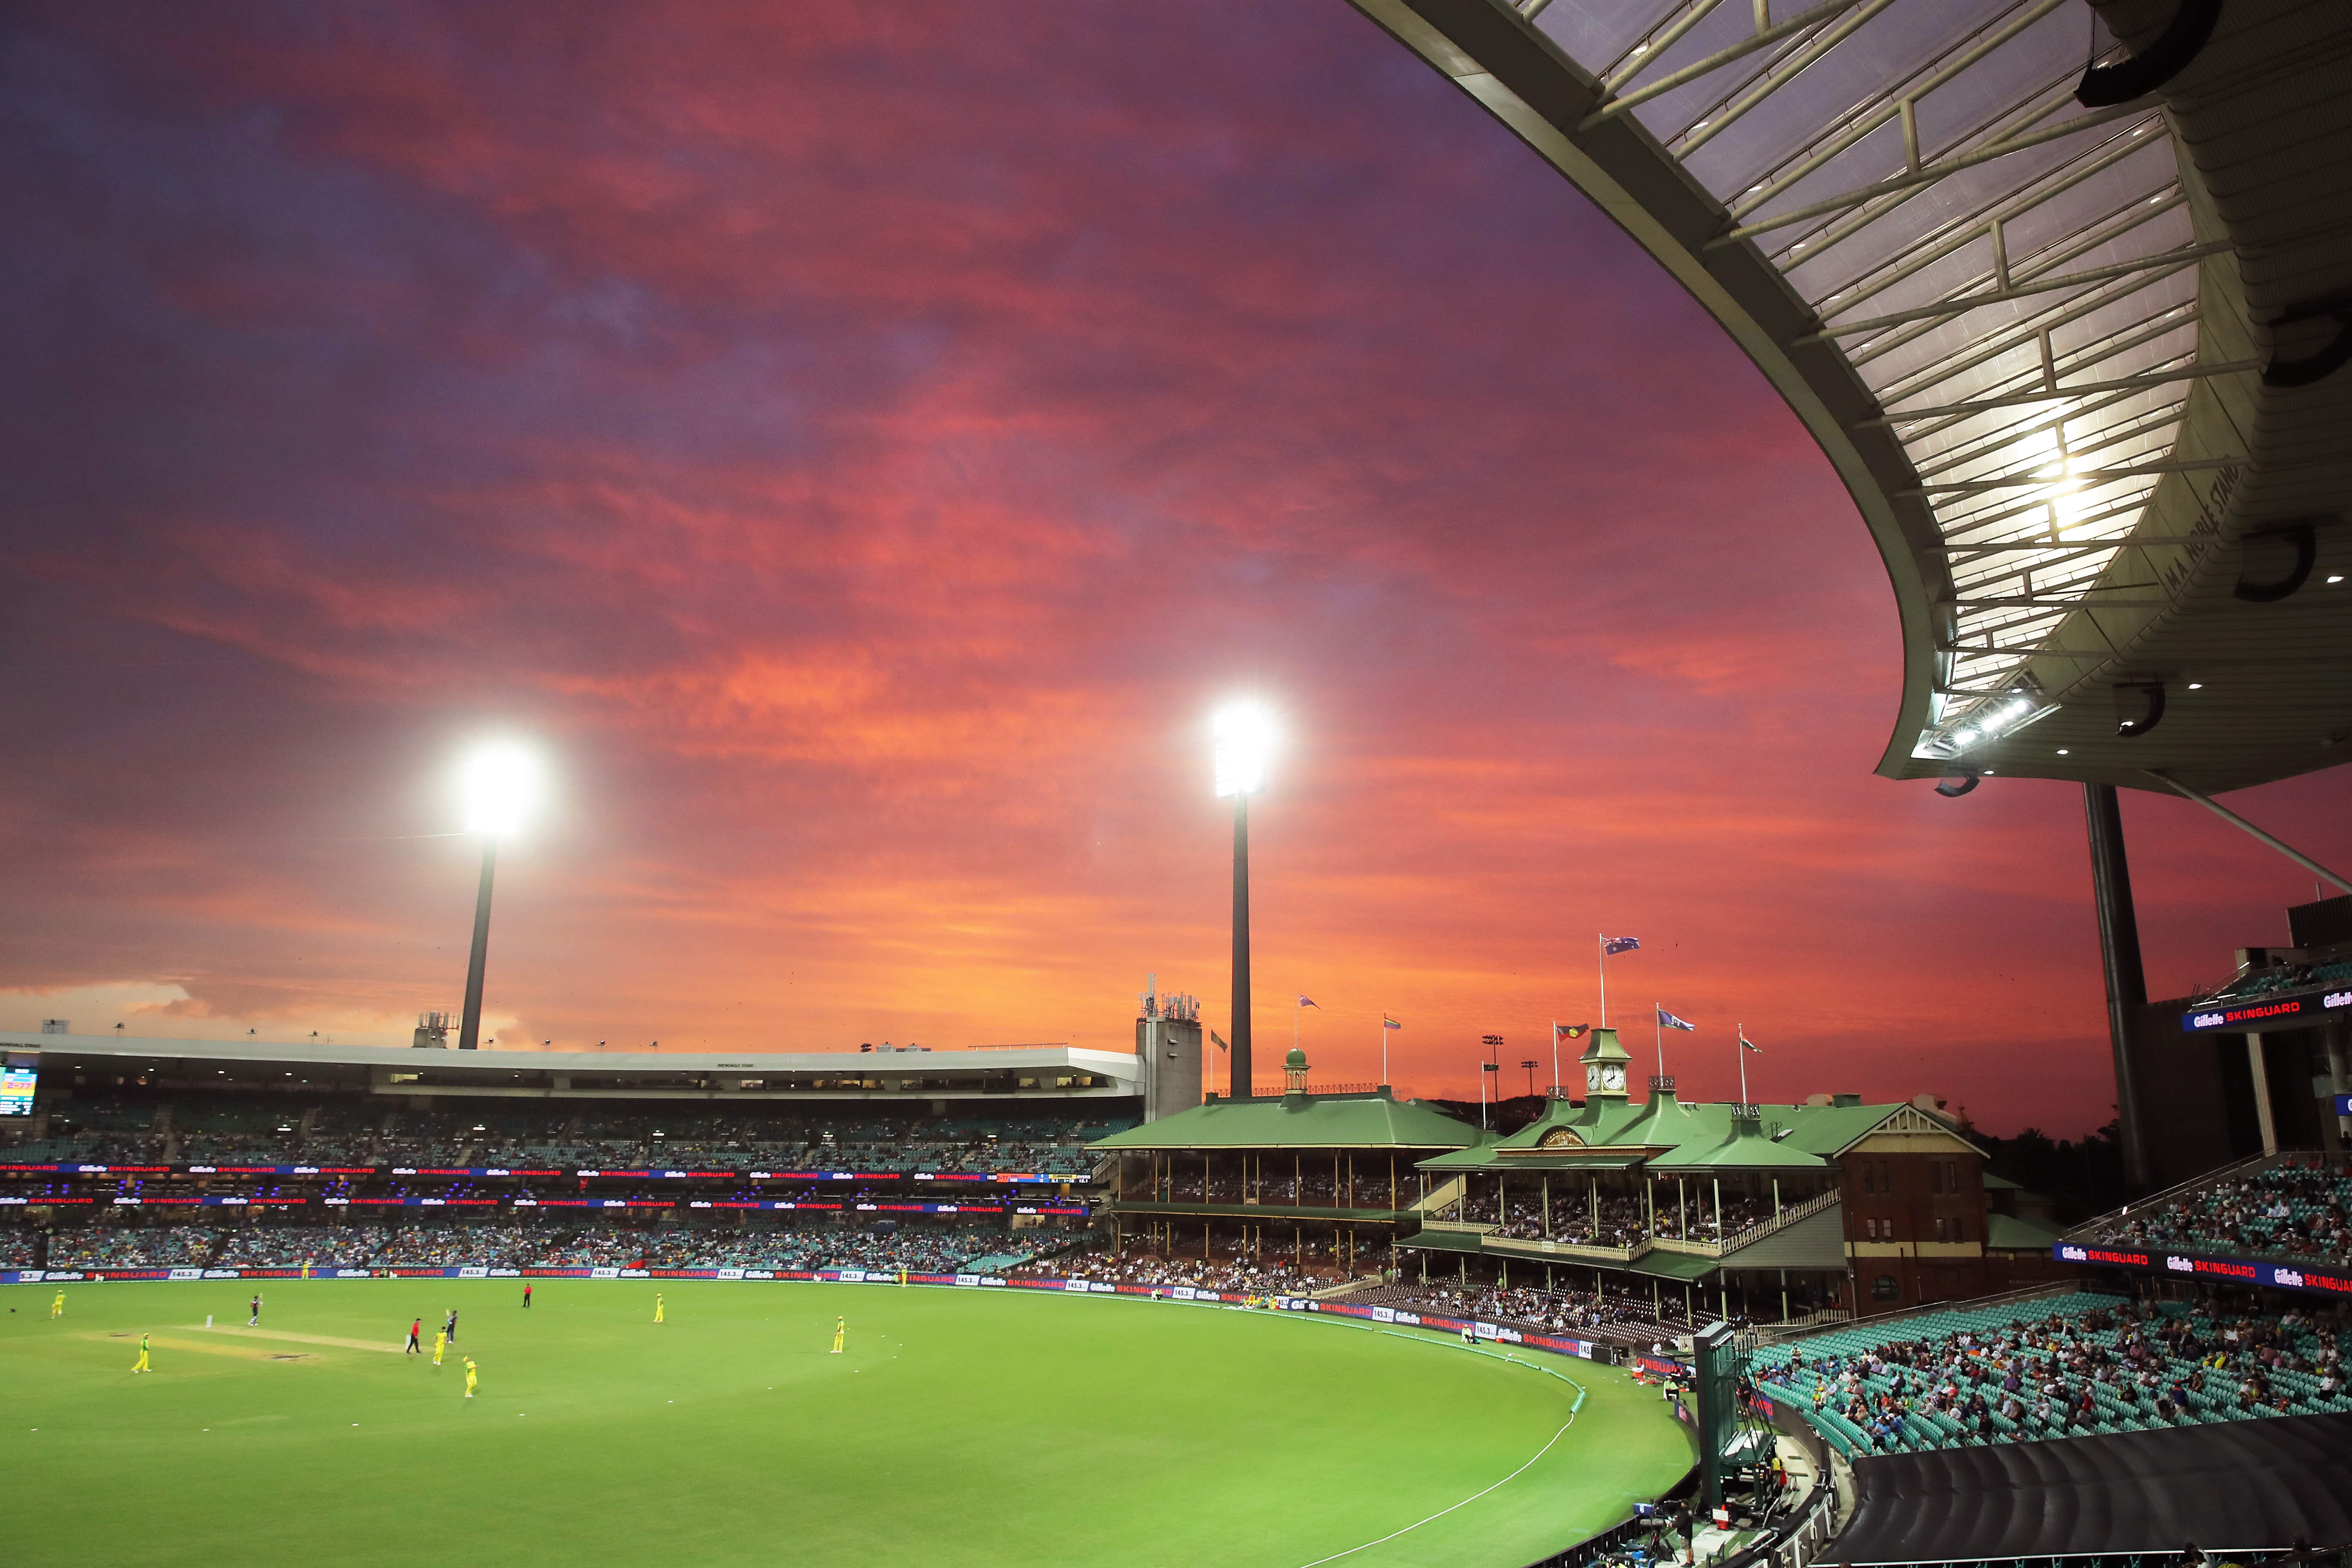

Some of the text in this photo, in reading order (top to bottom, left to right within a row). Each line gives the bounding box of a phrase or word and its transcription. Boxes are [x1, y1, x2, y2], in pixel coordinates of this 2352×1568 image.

[2324, 992, 2352, 1008] Gillett
[2194, 1002, 2300, 1027] Gillette SKINGUARD
[2063, 1247, 2148, 1265] Gillette SKINGUARD
[2167, 1256, 2255, 1278] Gillette SKINGUARD
[46, 1272, 83, 1280] Gillette
[204, 1270, 239, 1278] Gillette
[897, 1275, 955, 1283] SINGUARD
[2275, 1269, 2302, 1286] Gillette
[981, 1278, 1064, 1287] Gillette SKINGUARD
[1090, 1283, 1115, 1292] Gillette
[1196, 1291, 1220, 1301] Gillette
[1320, 1303, 1371, 1316] SKINGUARD
[1396, 1312, 1420, 1324] Gillette
[1477, 1326, 1490, 1335] 145.3
[1498, 1328, 1577, 1351] Gillette SKINGUARD
